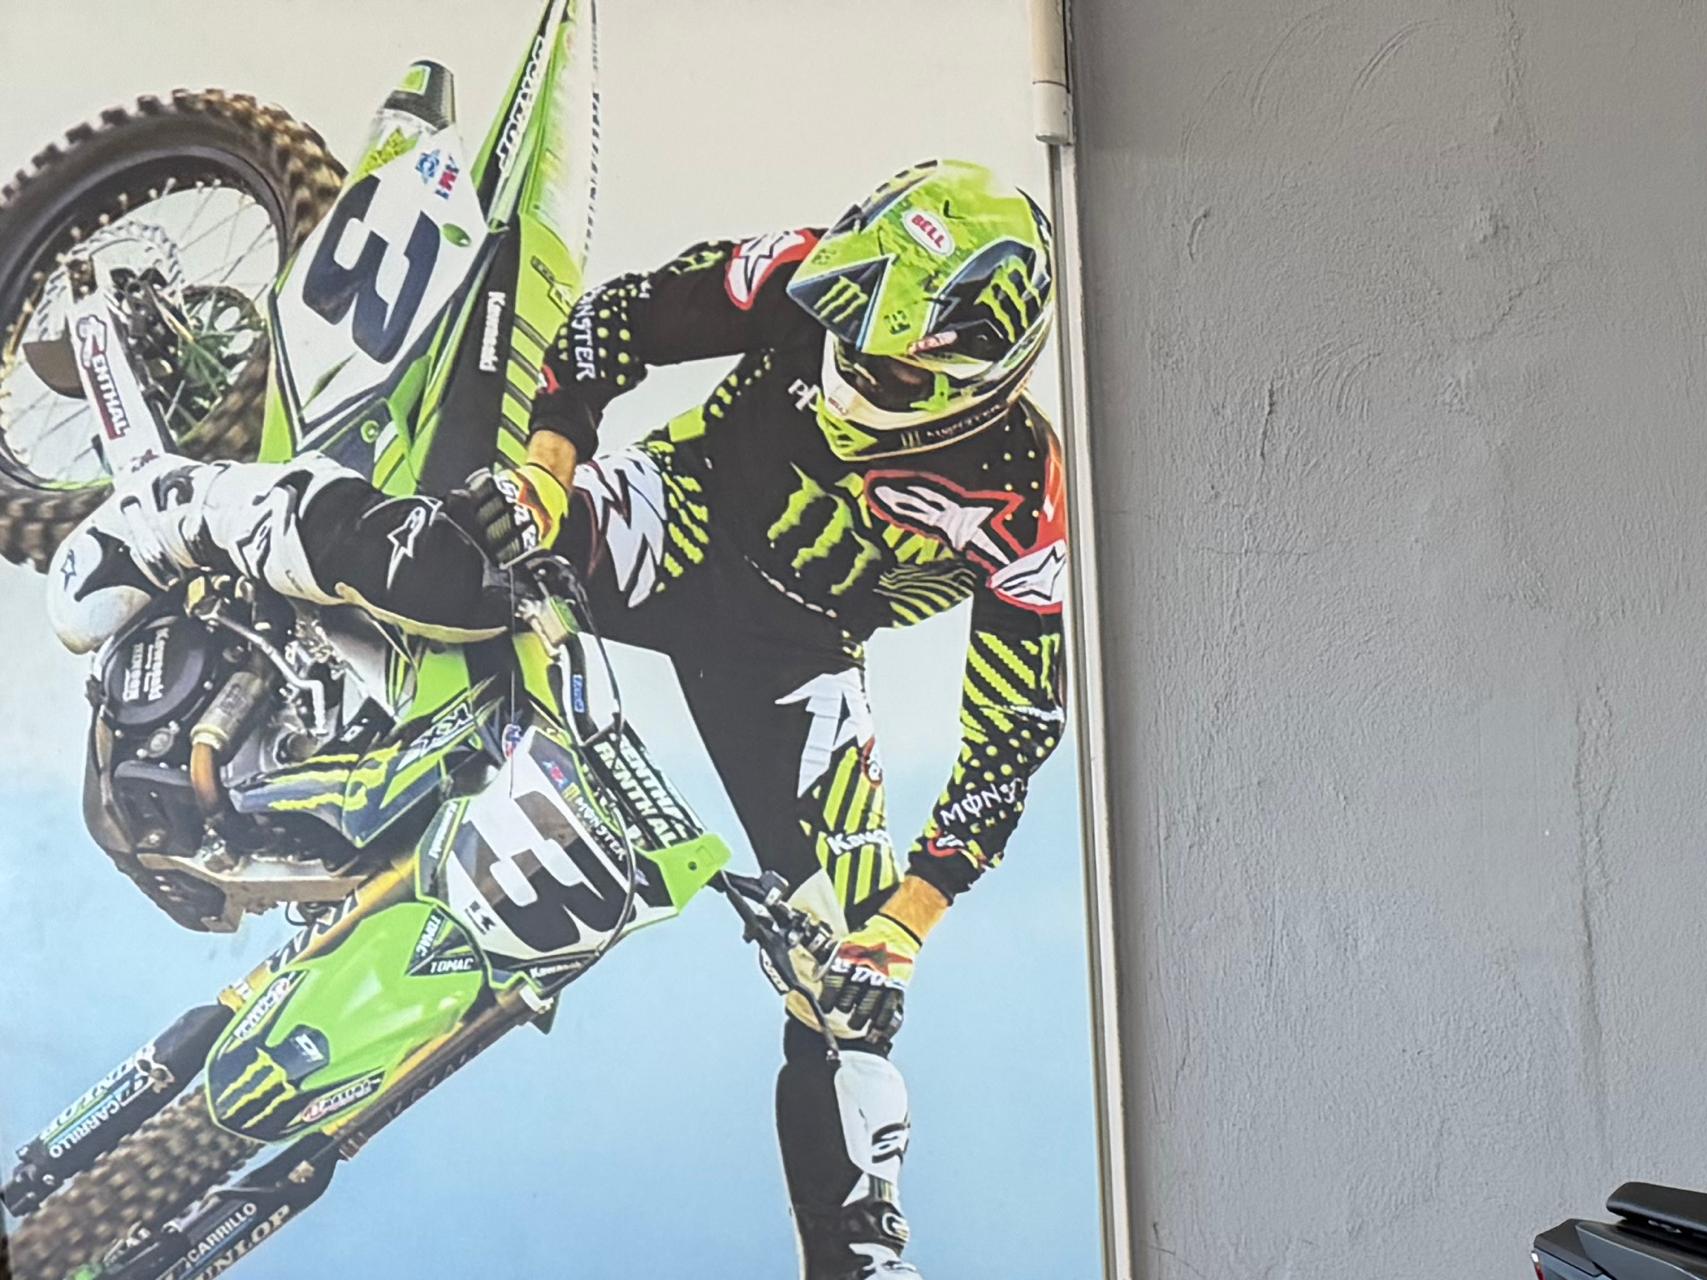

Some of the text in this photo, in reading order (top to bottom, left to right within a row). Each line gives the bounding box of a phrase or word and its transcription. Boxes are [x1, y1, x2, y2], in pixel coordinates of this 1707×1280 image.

[912, 214, 946, 250] BELL
[302, 173, 441, 364] 3
[570, 285, 607, 382] ONSTER
[447, 790, 634, 953] 3
[429, 957, 474, 974] TOMAC
[49, 1099, 120, 1159] CARRILLO
[186, 1202, 258, 1264] CARRILLO
